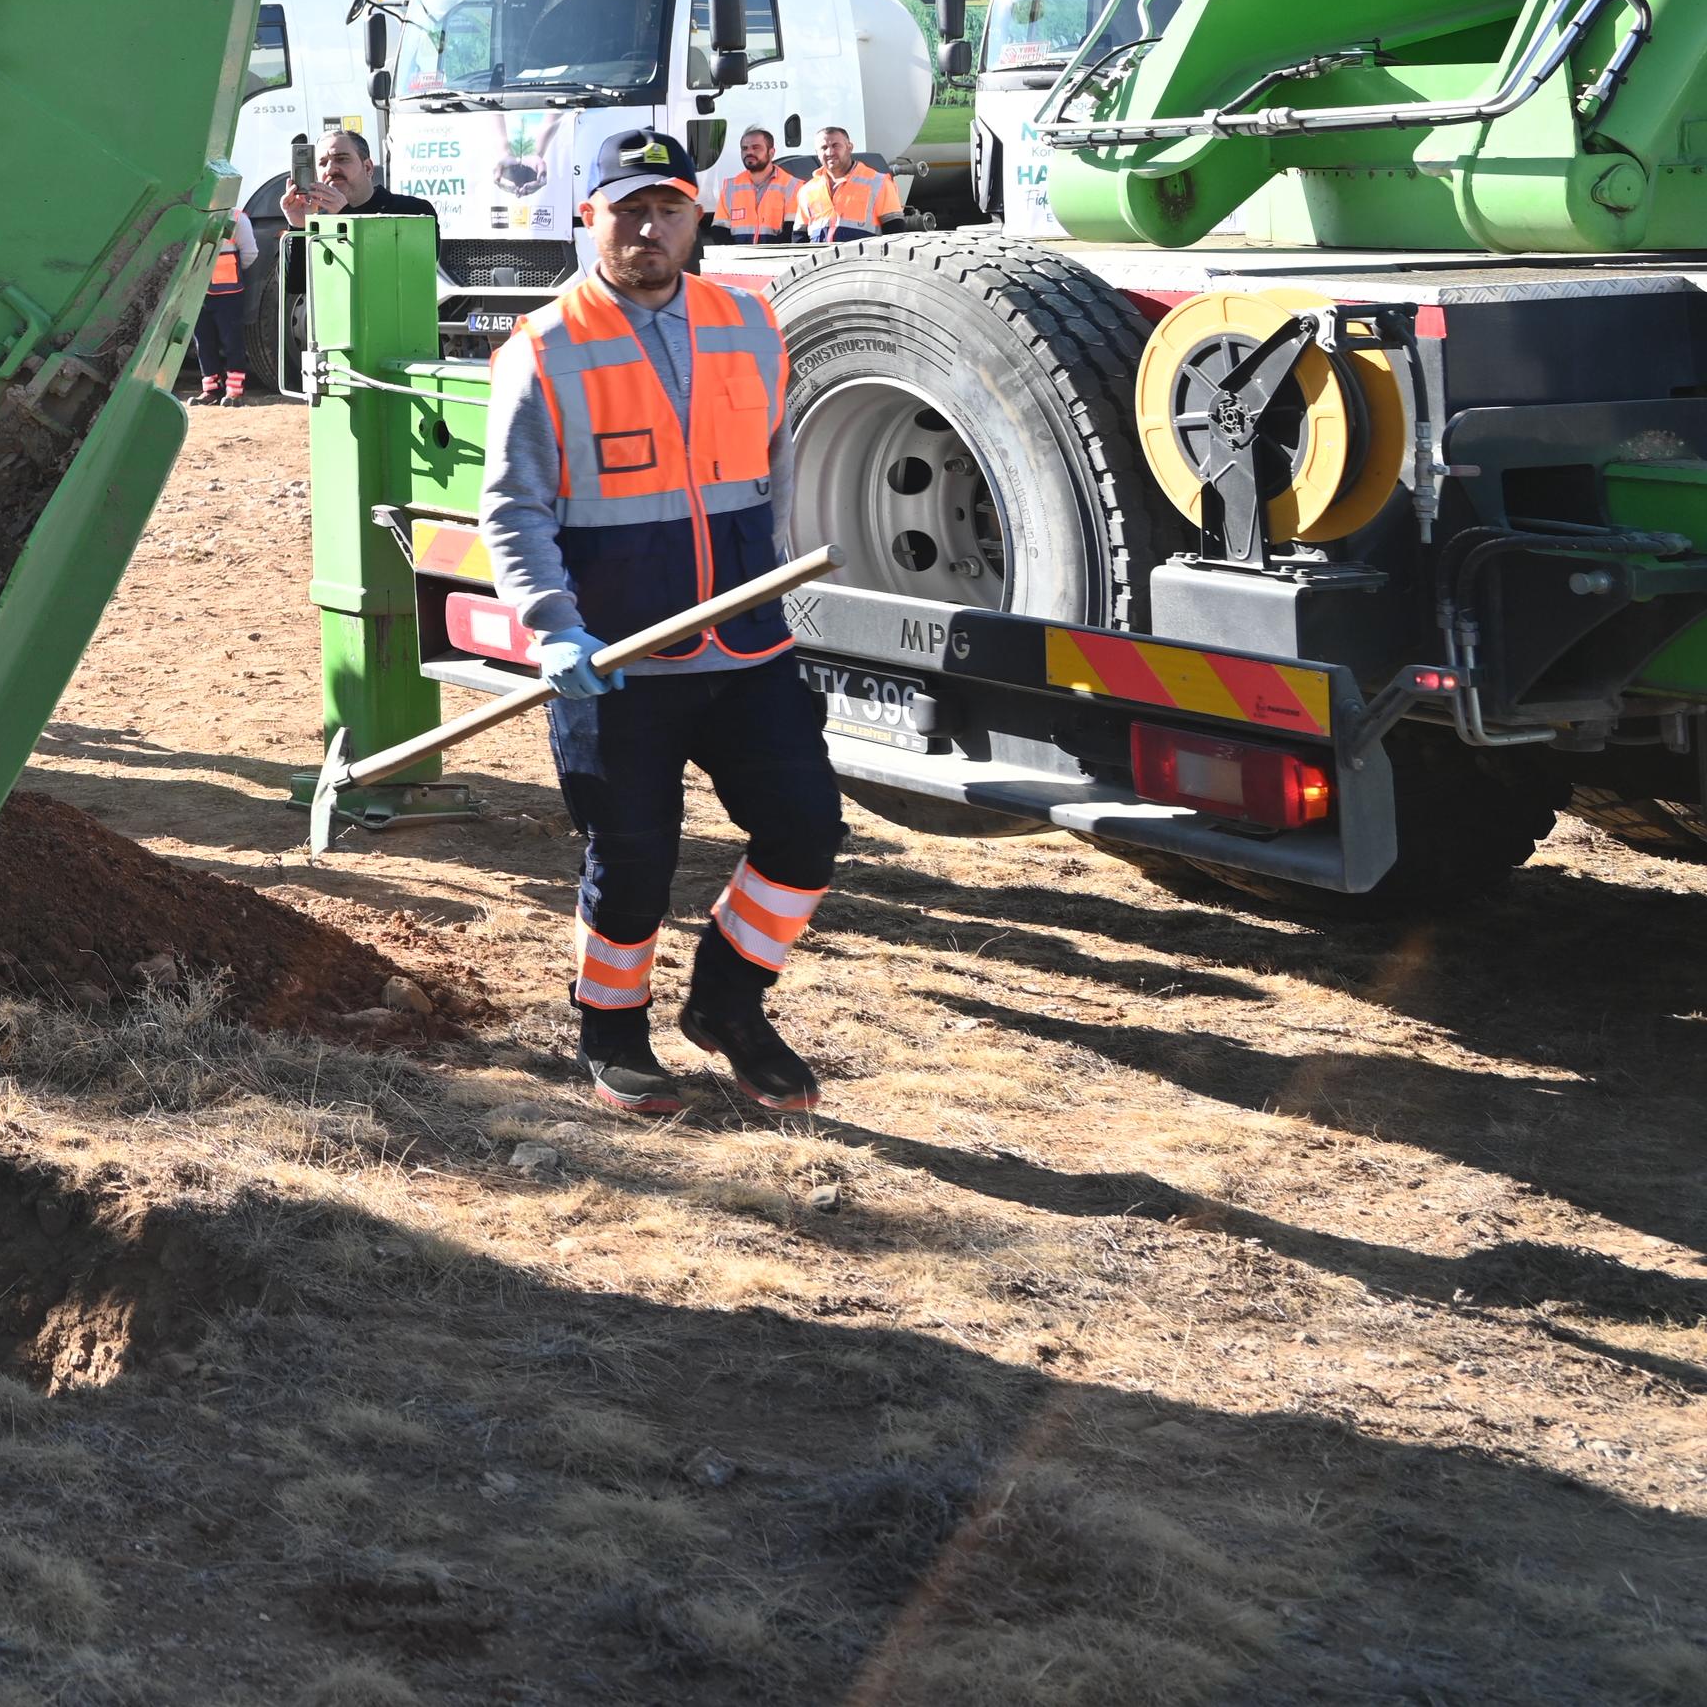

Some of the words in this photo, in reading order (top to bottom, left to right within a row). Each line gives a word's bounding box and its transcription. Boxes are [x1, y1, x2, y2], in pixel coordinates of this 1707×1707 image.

[404, 141, 461, 159] NEFES
[400, 178, 466, 196] HAYAT!
[475, 315, 490, 330] 42
[492, 315, 514, 331] AER
[797, 338, 897, 375] CONSTRUCTION
[900, 618, 971, 660] MPG
